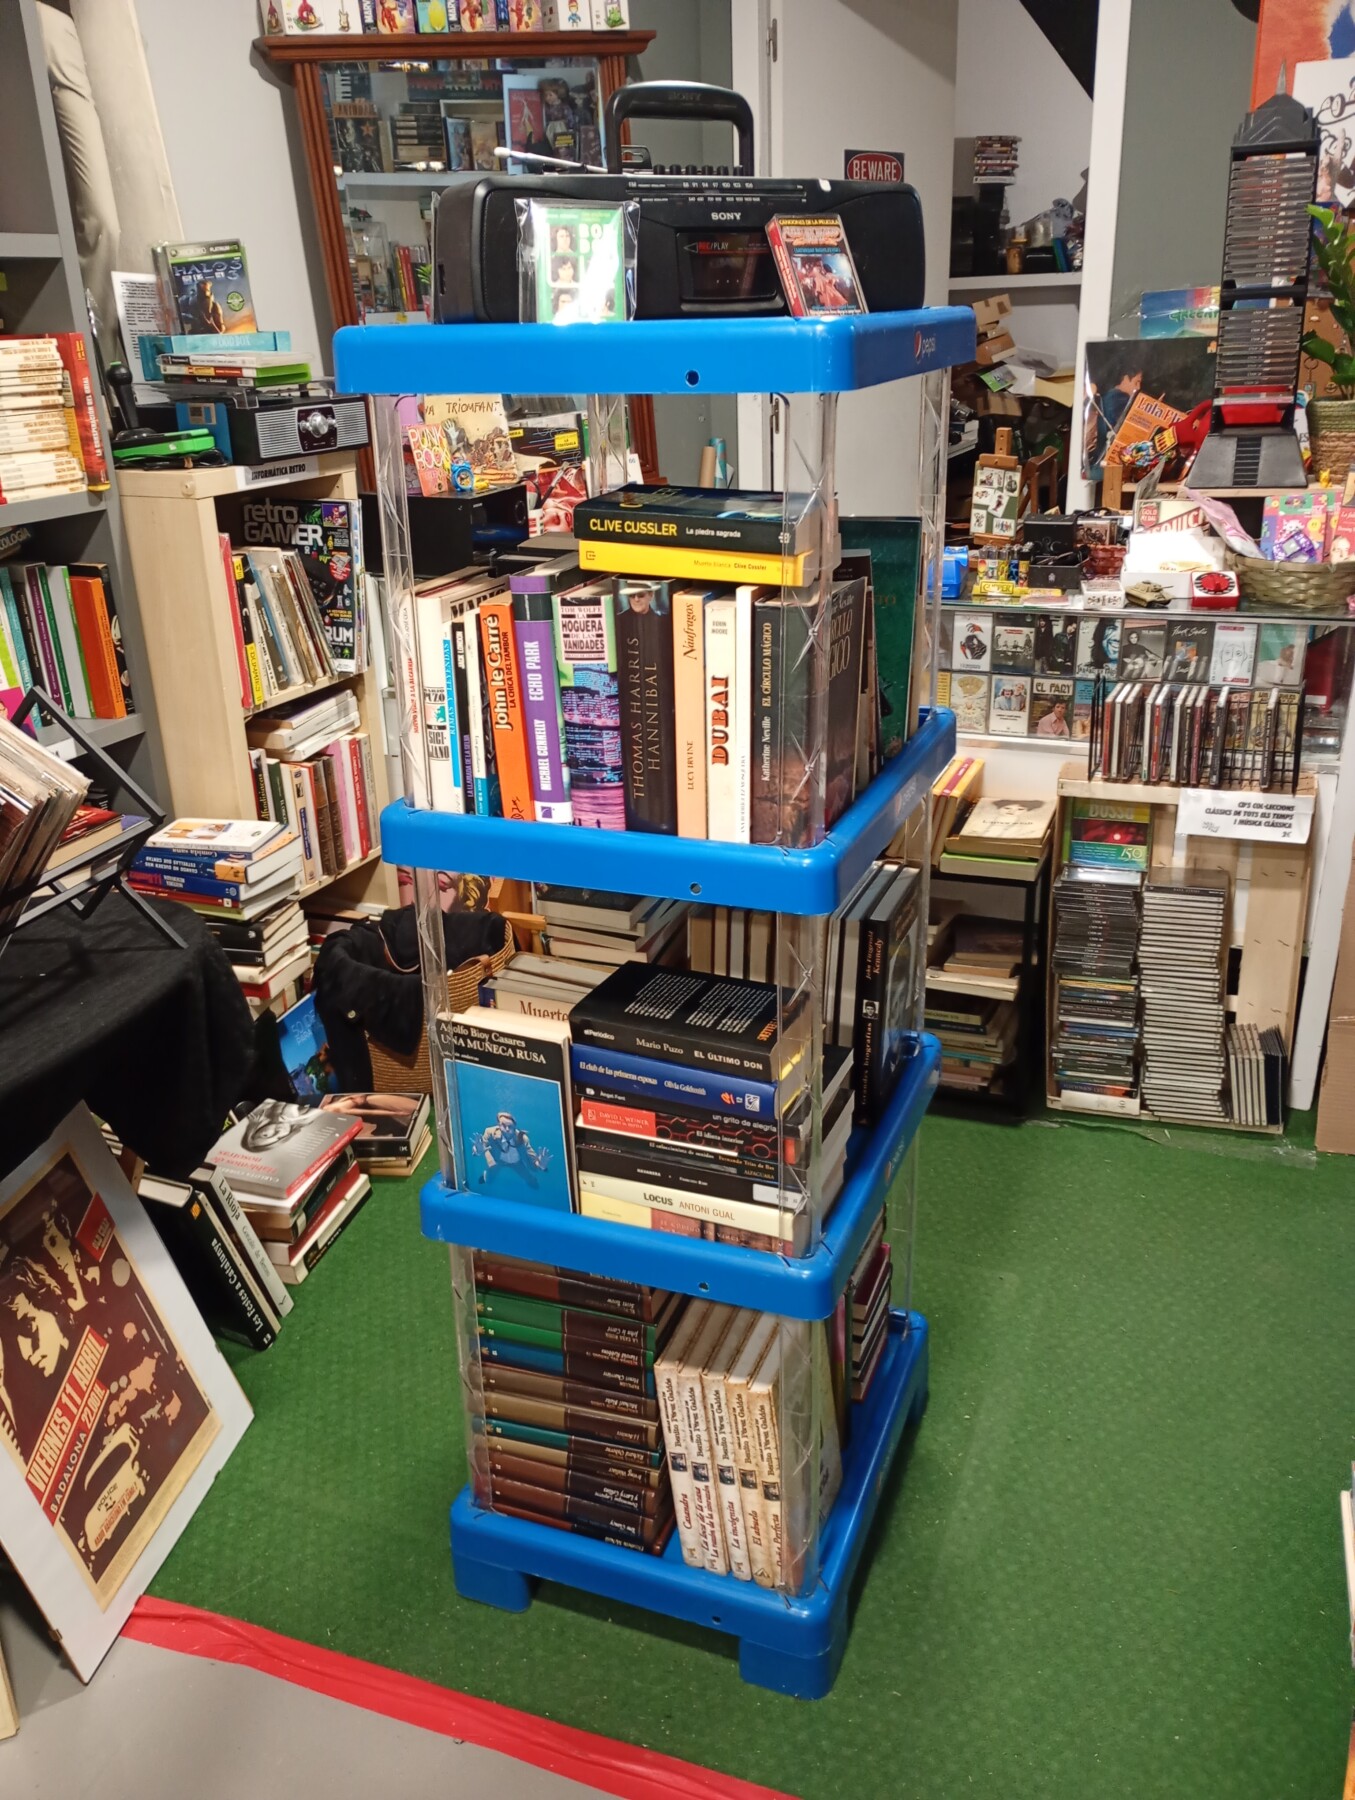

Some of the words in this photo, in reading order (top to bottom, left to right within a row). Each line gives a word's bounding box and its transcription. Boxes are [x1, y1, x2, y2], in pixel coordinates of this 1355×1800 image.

[853, 160, 897, 182] BEWARE
[711, 212, 742, 221] SONY
[173, 261, 228, 276] HALO
[446, 399, 500, 415] TRIOMFANT
[1137, 397, 1163, 417] Lola
[410, 425, 443, 448] PUNK
[289, 464, 306, 475] RETRO
[244, 498, 298, 523] retro
[1141, 508, 1157, 516] GOLD
[244, 522, 323, 546] GAMER
[590, 519, 622, 533] CLIVE
[624, 520, 677, 536] CUSSLER
[686, 527, 694, 535] La
[695, 528, 715, 538] piedra
[716, 530, 741, 539] sagrada
[562, 619, 603, 632] HOGUERA
[683, 602, 698, 660] Náufragos
[487, 613, 503, 667] Carré
[502, 632, 513, 660] TAMBOR
[563, 638, 605, 651] VANIDADES
[760, 622, 772, 657] MÁGICO
[458, 655, 466, 669] JACK
[523, 641, 541, 670] PARK
[492, 667, 505, 689] le
[529, 672, 544, 701] ECHO
[626, 637, 641, 714] HARRIS
[760, 658, 772, 696] CÍRCULO
[1035, 683, 1047, 693] EL
[1050, 682, 1072, 695] FARY
[495, 690, 514, 731] John
[510, 699, 517, 708] LA
[762, 696, 771, 708] EL
[644, 662, 660, 771] HANNIBAL
[711, 674, 729, 767] DUBAI
[533, 718, 549, 757] CONNELLY
[761, 716, 772, 745] Neville
[631, 722, 645, 799] THOMAS
[686, 740, 694, 766] IRVINE
[761, 746, 771, 782] Katherine
[537, 757, 552, 791] MICHAEL
[520, 1001, 569, 1022] Muerte
[470, 1027, 489, 1041] Bioy
[491, 1032, 526, 1048] Casares
[468, 1039, 514, 1058] MUÑECA
[516, 1051, 547, 1064] RUSA
[636, 1037, 661, 1050] Mario
[663, 1043, 684, 1055] Puzo
[694, 1050, 705, 1059] EL
[707, 1052, 741, 1066] ÚLTIMO
[743, 1060, 763, 1070] DON
[586, 1063, 598, 1071] club
[599, 1111, 618, 1120] DAVID
[703, 1132, 721, 1141] idiota
[721, 1135, 745, 1145] interior
[723, 1117, 740, 1126] grito
[741, 1119, 751, 1127] de
[217, 1180, 227, 1194] La
[225, 1193, 241, 1221] Rioja
[643, 1192, 673, 1206] LOCUS
[679, 1200, 710, 1215] ANTONI
[712, 1208, 735, 1221] GUAL
[211, 1238, 238, 1284] Catalunya
[238, 1287, 253, 1317] Festes
[252, 1314, 264, 1332] Les
[27, 1409, 72, 1493] VIERNES
[61, 1383, 82, 1414] 11
[72, 1332, 105, 1386] ABRIL
[722, 1438, 730, 1460] Benito
[763, 1431, 771, 1452] Pérez
[50, 1431, 88, 1514] BADALONA
[767, 1455, 775, 1476] Benito
[97, 1482, 118, 1511] POLICE
[748, 1510, 761, 1534] abuelo
[733, 1538, 741, 1550] La
[753, 1535, 763, 1546] El
